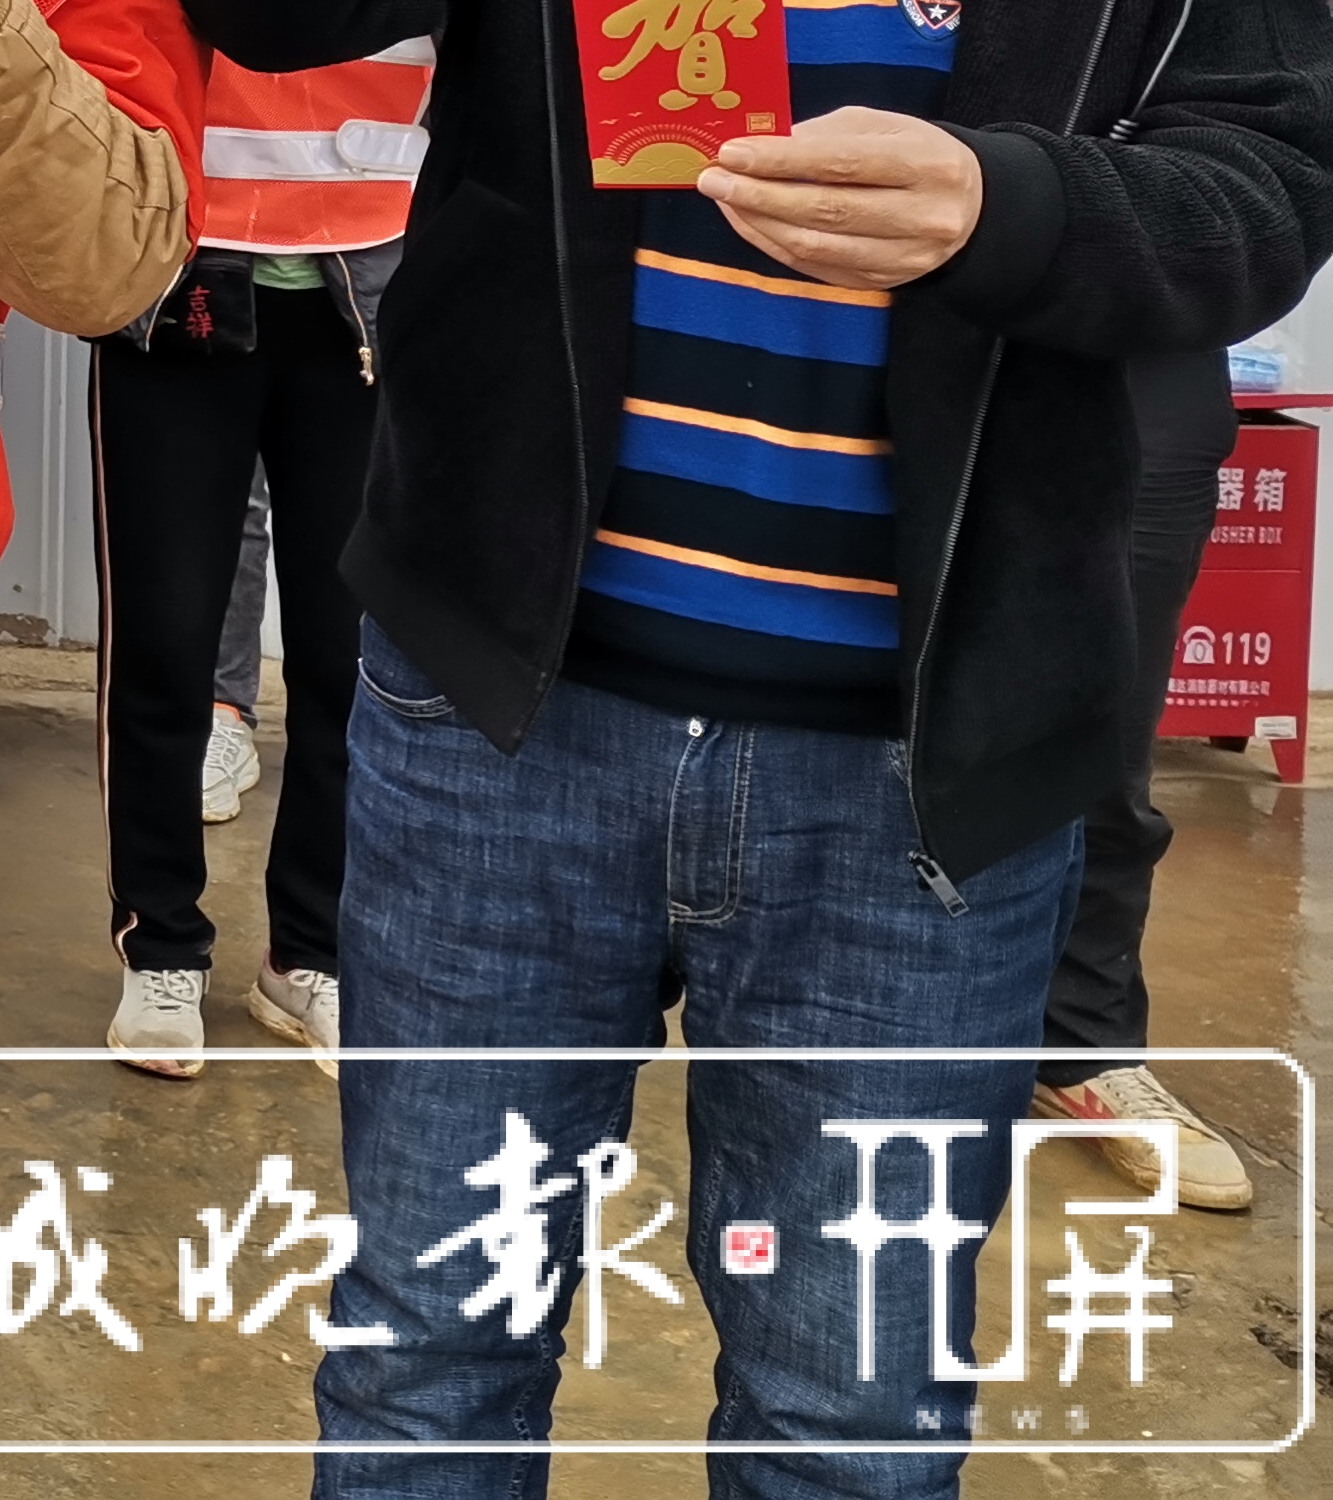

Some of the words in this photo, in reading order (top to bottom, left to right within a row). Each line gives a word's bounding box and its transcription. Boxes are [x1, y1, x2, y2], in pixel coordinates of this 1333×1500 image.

[186, 285, 214, 338] 吉祥
[1216, 467, 1287, 512] 器箱
[1222, 632, 1271, 665] 119
